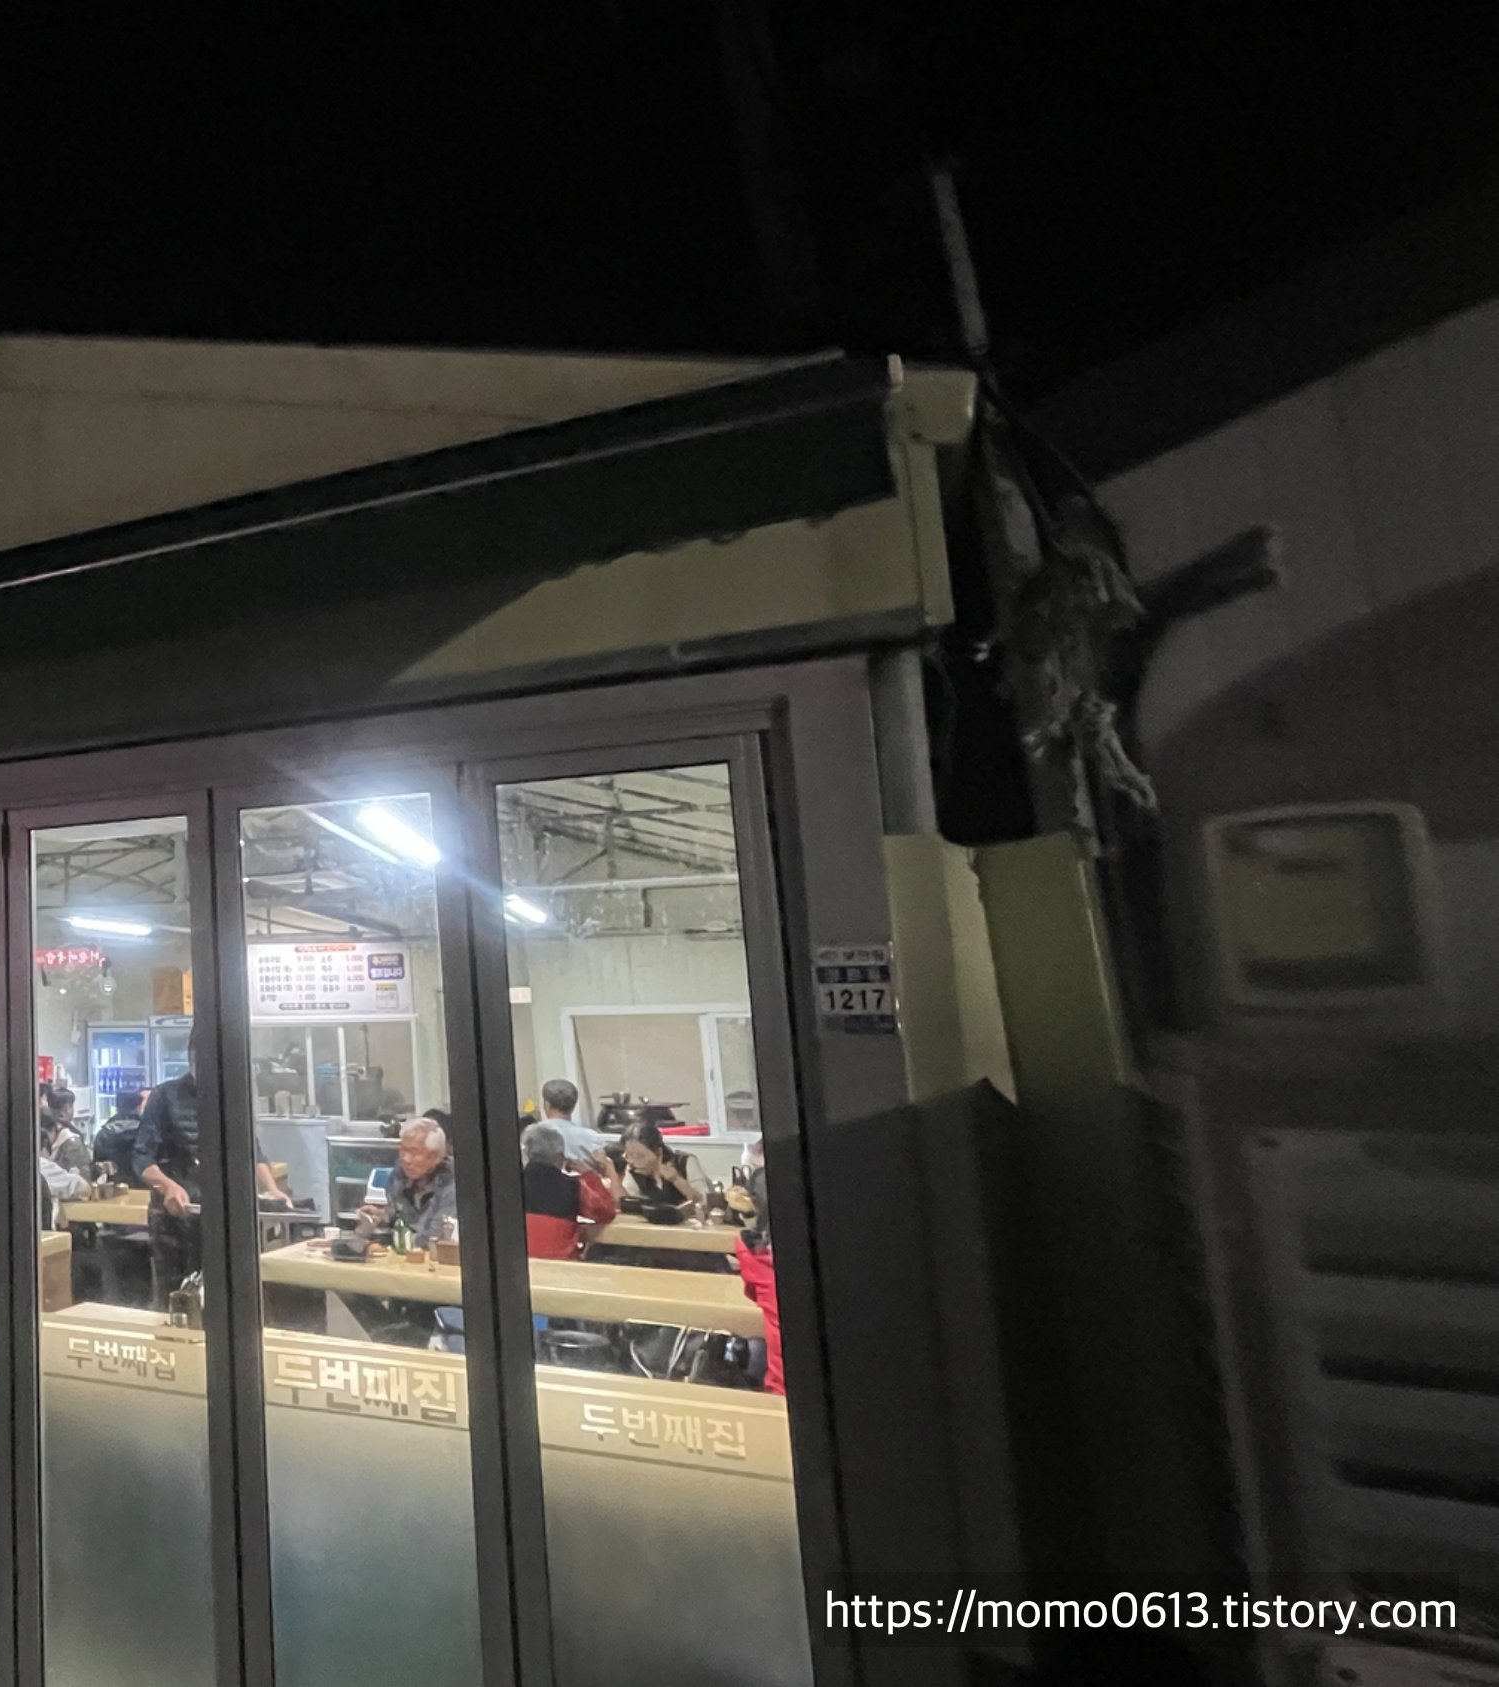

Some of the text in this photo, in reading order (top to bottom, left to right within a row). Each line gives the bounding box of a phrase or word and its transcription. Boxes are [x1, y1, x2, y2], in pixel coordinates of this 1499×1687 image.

[825, 988, 885, 1010] 1217
[67, 1337, 176, 1382] 두번째집
[274, 1353, 457, 1424] 두번째집
[580, 1403, 747, 1461] 두번째집
